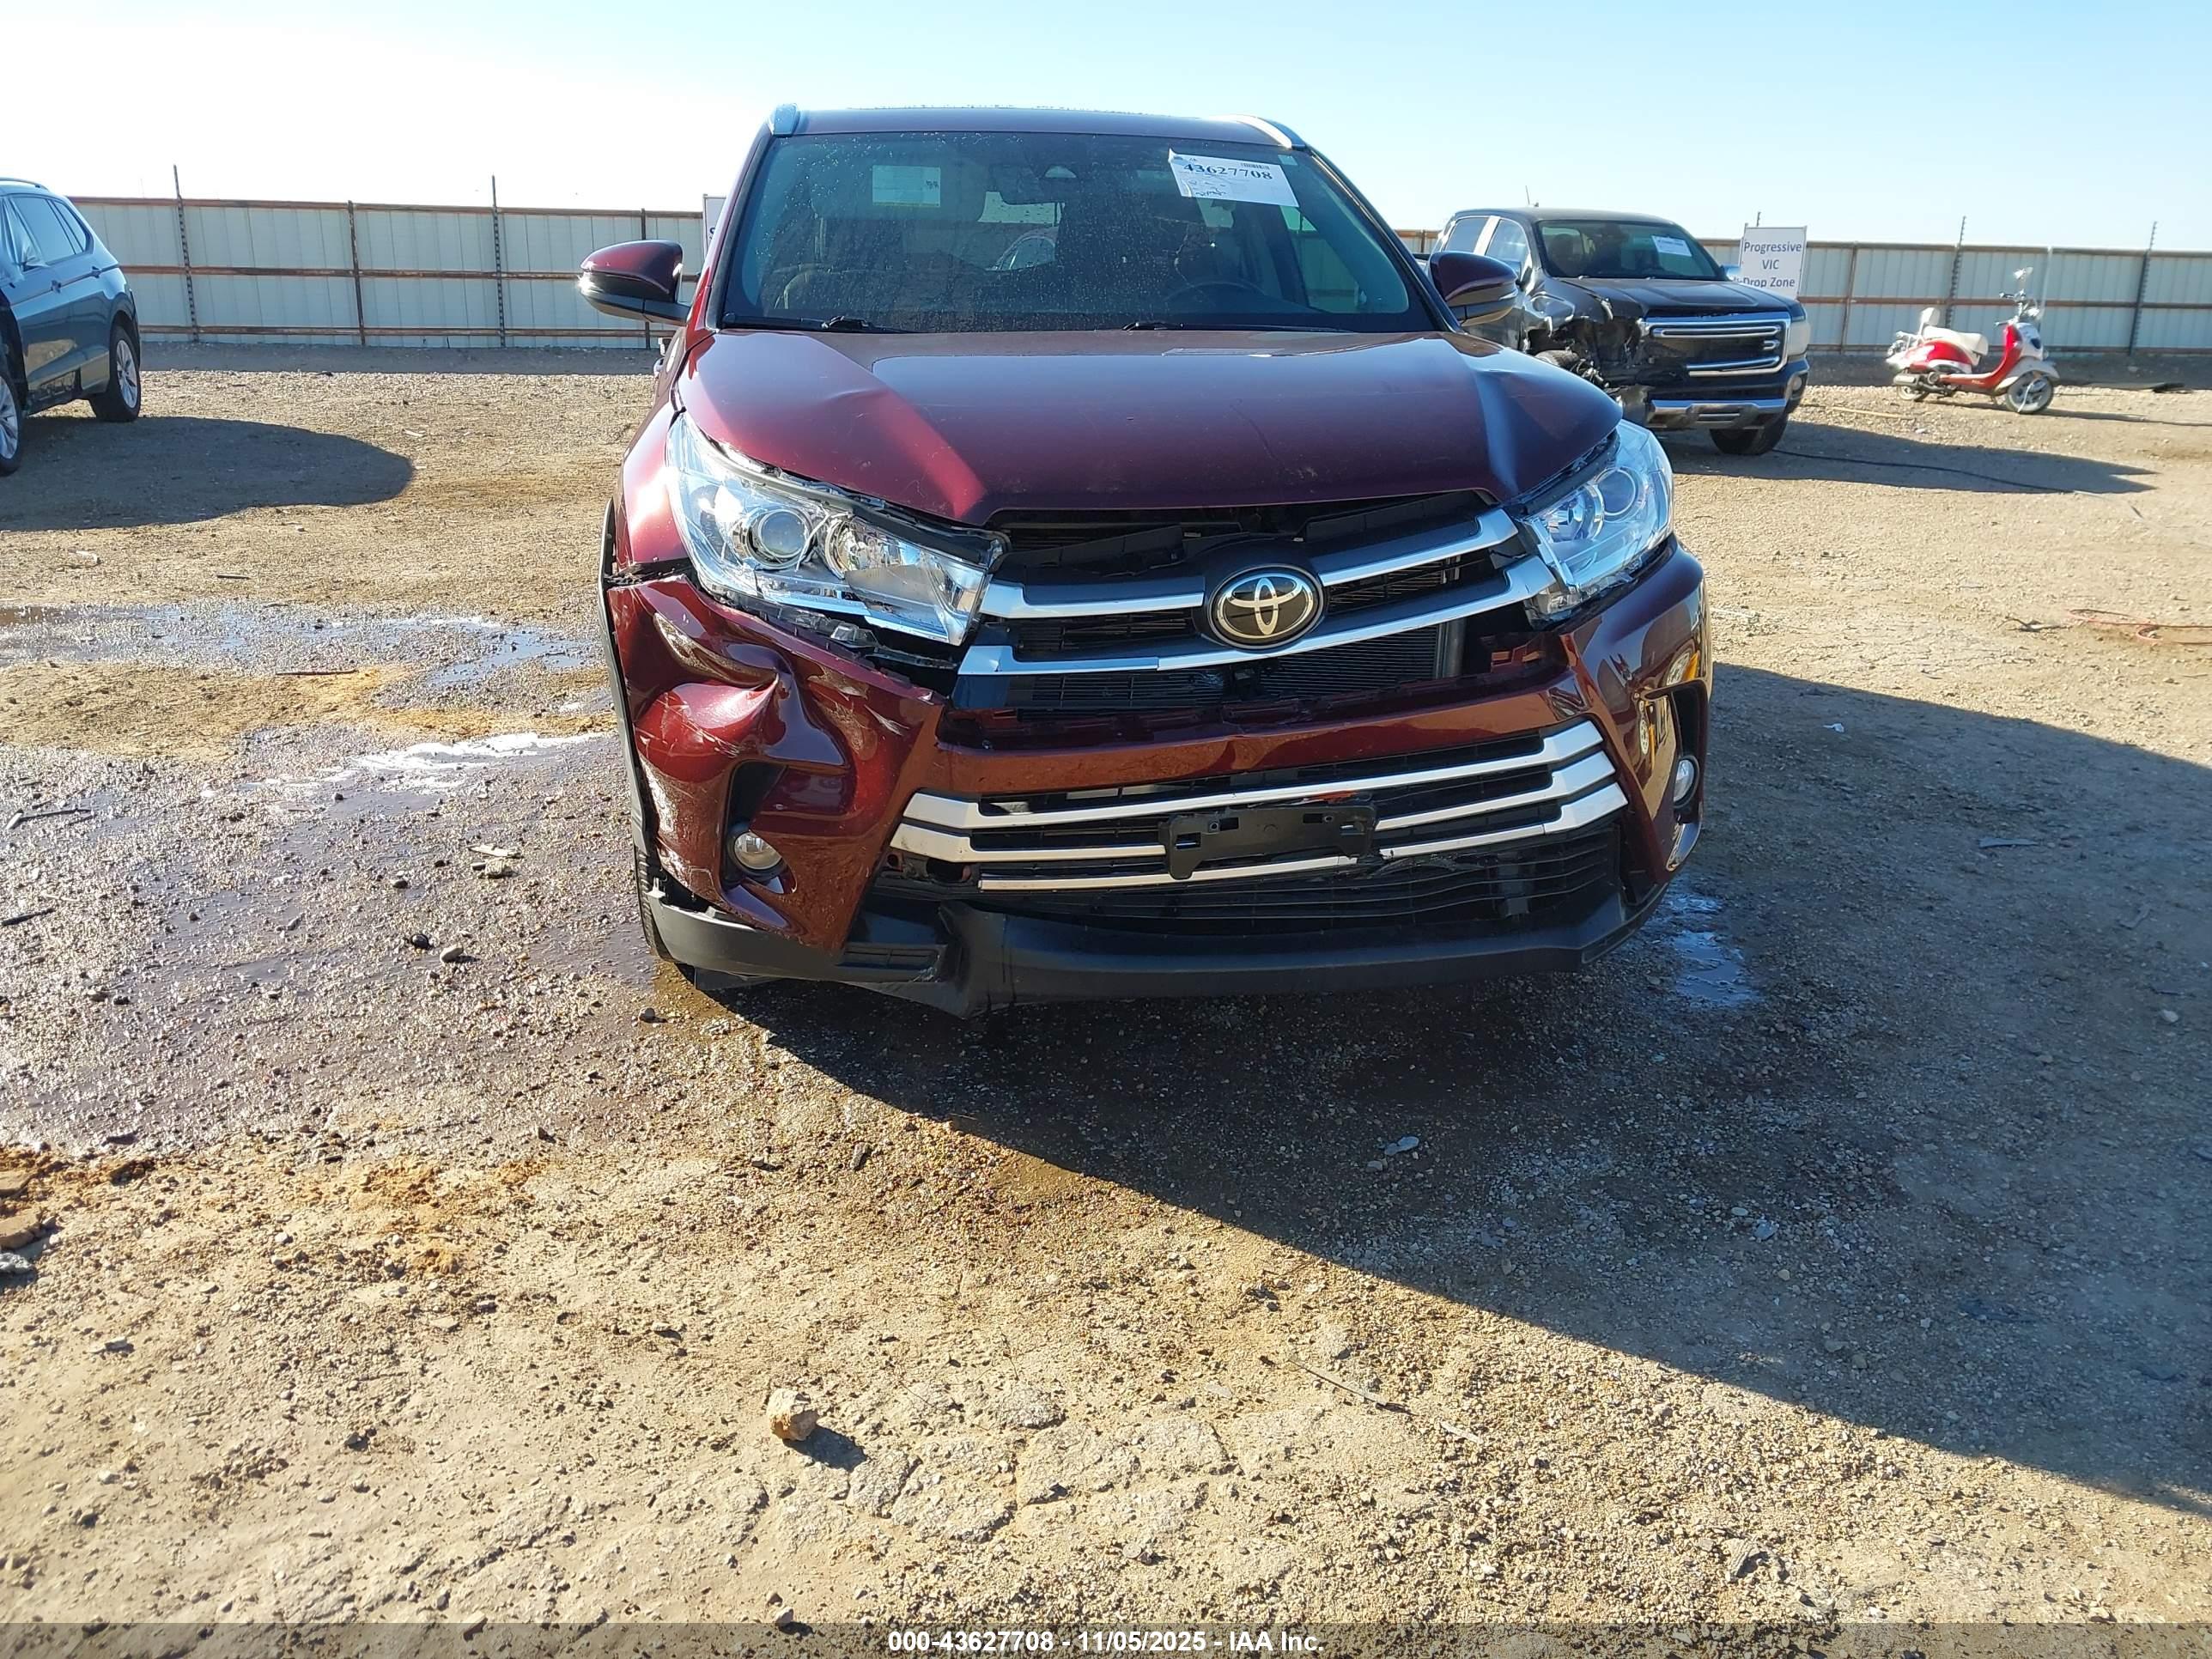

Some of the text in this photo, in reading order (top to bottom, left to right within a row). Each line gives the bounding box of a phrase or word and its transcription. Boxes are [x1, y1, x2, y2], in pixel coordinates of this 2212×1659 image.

[1183, 163, 1273, 180] 43627708
[1743, 240, 1802, 255] Progressive
[1762, 259, 1780, 270] VIC
[1743, 276, 1796, 289] Drop Zone
